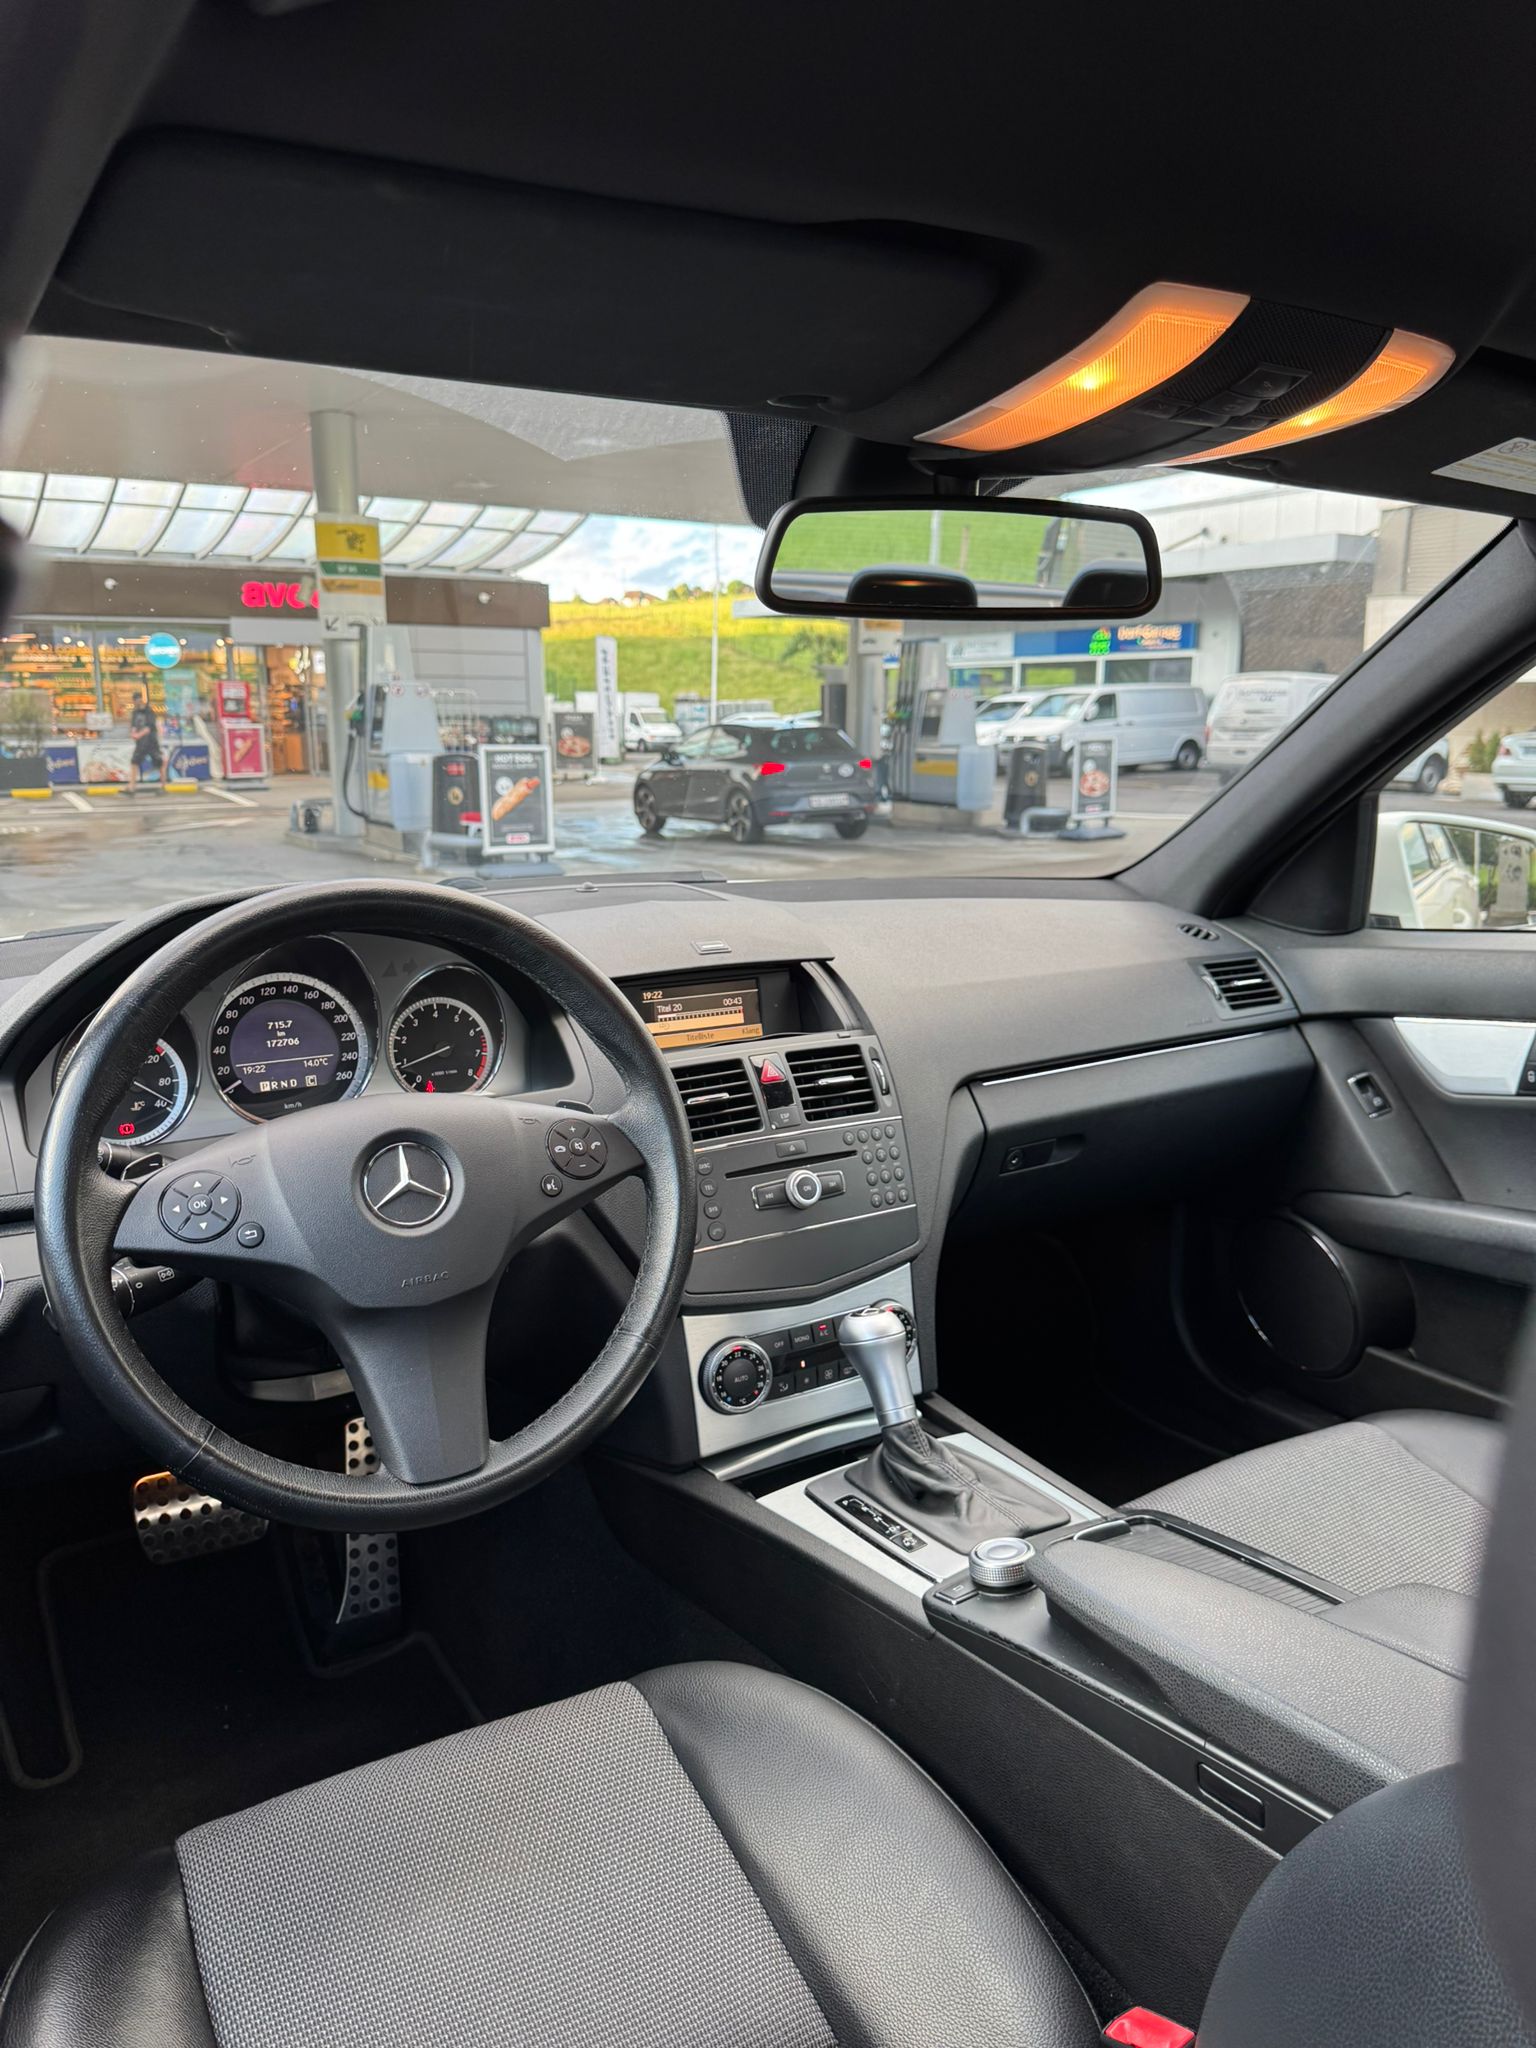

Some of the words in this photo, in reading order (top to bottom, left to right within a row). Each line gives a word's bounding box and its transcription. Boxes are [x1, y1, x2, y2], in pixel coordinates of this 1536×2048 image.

[260, 987, 276, 996] 120
[283, 985, 298, 994] 140
[304, 991, 319, 1000] 160
[643, 990, 663, 1000] 19:22
[239, 996, 255, 1005] 100
[321, 1001, 335, 1010] 180
[657, 1005, 671, 1013] Titel
[672, 1003, 682, 1012] 20
[225, 1010, 238, 1019] 80
[333, 1014, 348, 1024] 200
[267, 1020, 293, 1030] 715.7
[216, 1026, 230, 1035] 60
[341, 1032, 356, 1041] 220
[266, 1038, 300, 1048] 172706
[212, 1045, 226, 1054] 40
[144, 1055, 160, 1064] 20
[341, 1052, 358, 1061] 240
[217, 1066, 230, 1075] 20
[242, 1065, 266, 1074] 19:22
[335, 1072, 352, 1081] 260
[158, 1077, 171, 1086] 80
[271, 1081, 278, 1090] R
[280, 1080, 288, 1089] N
[290, 1079, 298, 1088] D
[154, 1099, 168, 1108] 40
[193, 1200, 207, 1209] OK
[774, 1341, 784, 1349] OFF
[794, 1335, 810, 1343] MONO
[734, 1375, 749, 1383] AUTO
